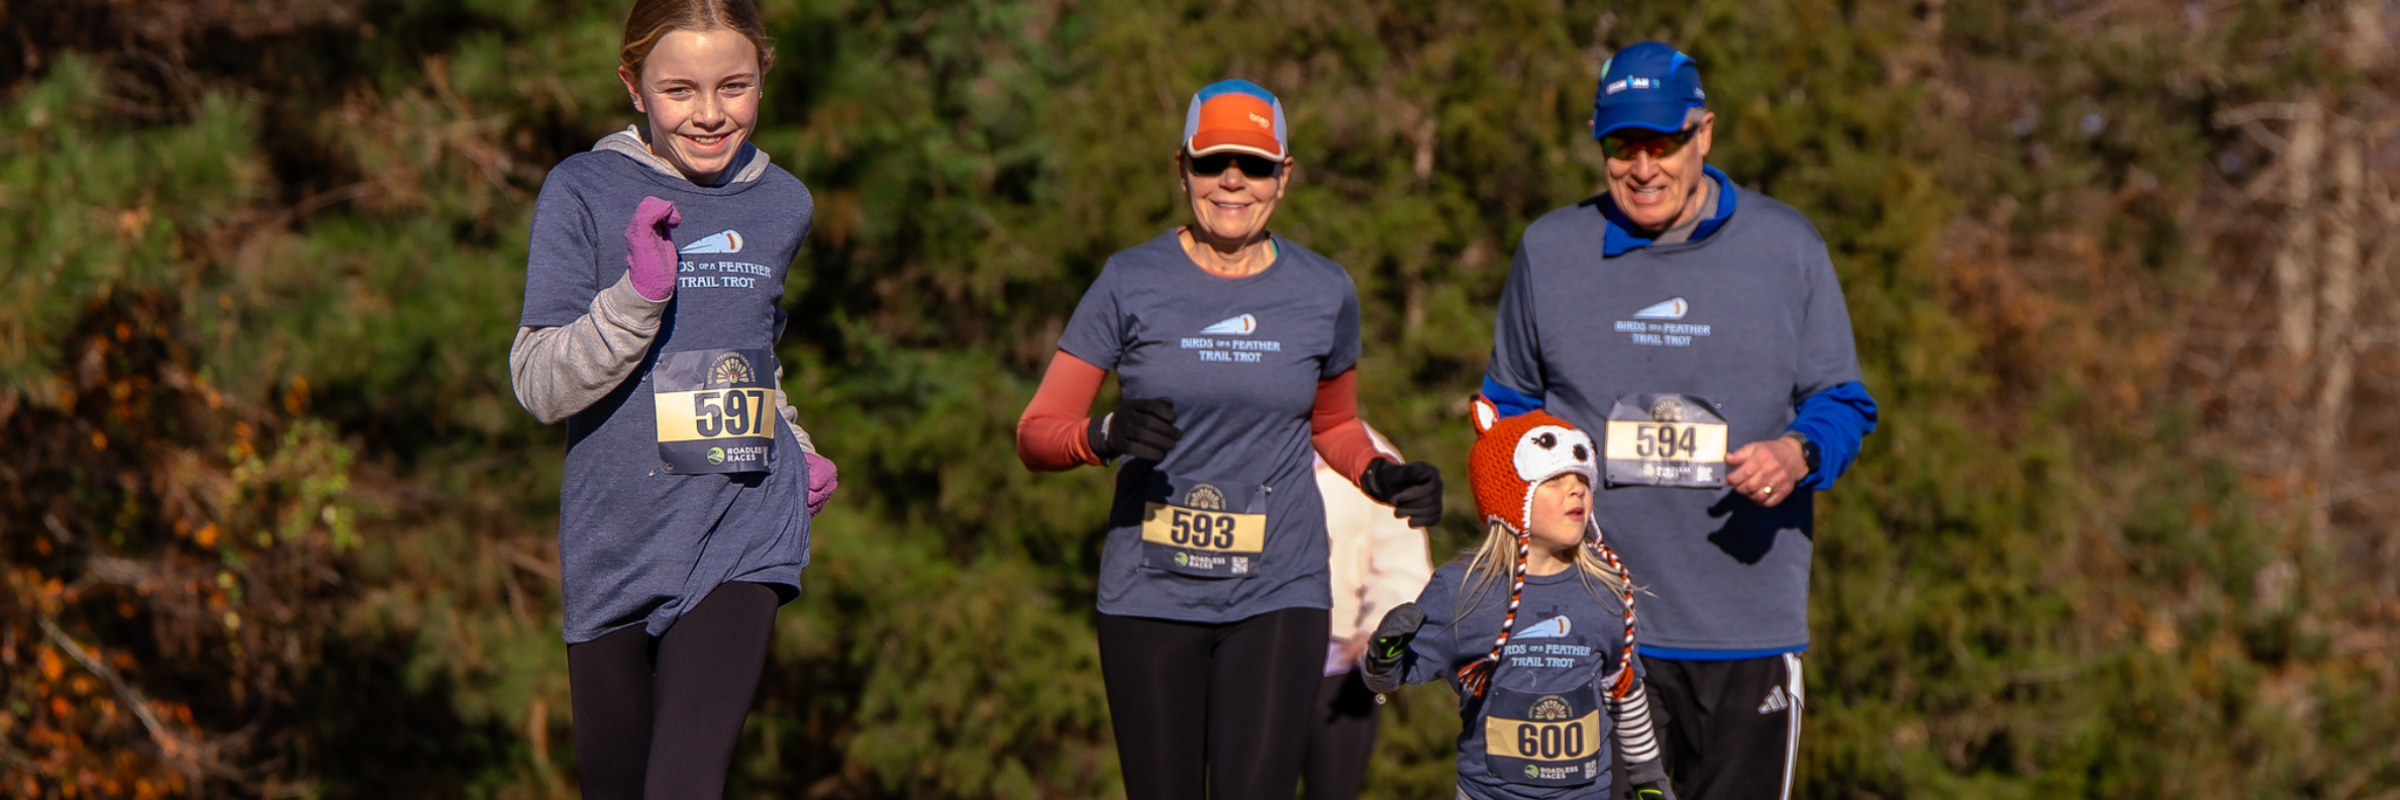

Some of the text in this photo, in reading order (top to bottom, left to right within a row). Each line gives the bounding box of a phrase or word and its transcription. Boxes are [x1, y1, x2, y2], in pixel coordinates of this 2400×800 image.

[718, 261, 772, 278] FEATHER
[679, 276, 755, 288] TRAIL TROT
[1614, 320, 1646, 333] BIRDS
[1663, 323, 1711, 336] FEATHER
[1181, 337, 1214, 349] BIRDS
[1232, 340, 1281, 352] FEATHER
[1631, 333, 1692, 347] TRAIL TROT
[1199, 350, 1263, 363] TRAIL TROT
[694, 389, 764, 438] 597
[1636, 424, 1697, 458] 594
[727, 453, 756, 462] RACES
[1171, 509, 1236, 549] 593
[1504, 644, 1527, 656] RDS
[1545, 644, 1591, 656] FEATHER
[1511, 657, 1575, 668] TRAIL TROT
[1518, 722, 1584, 759] 600
